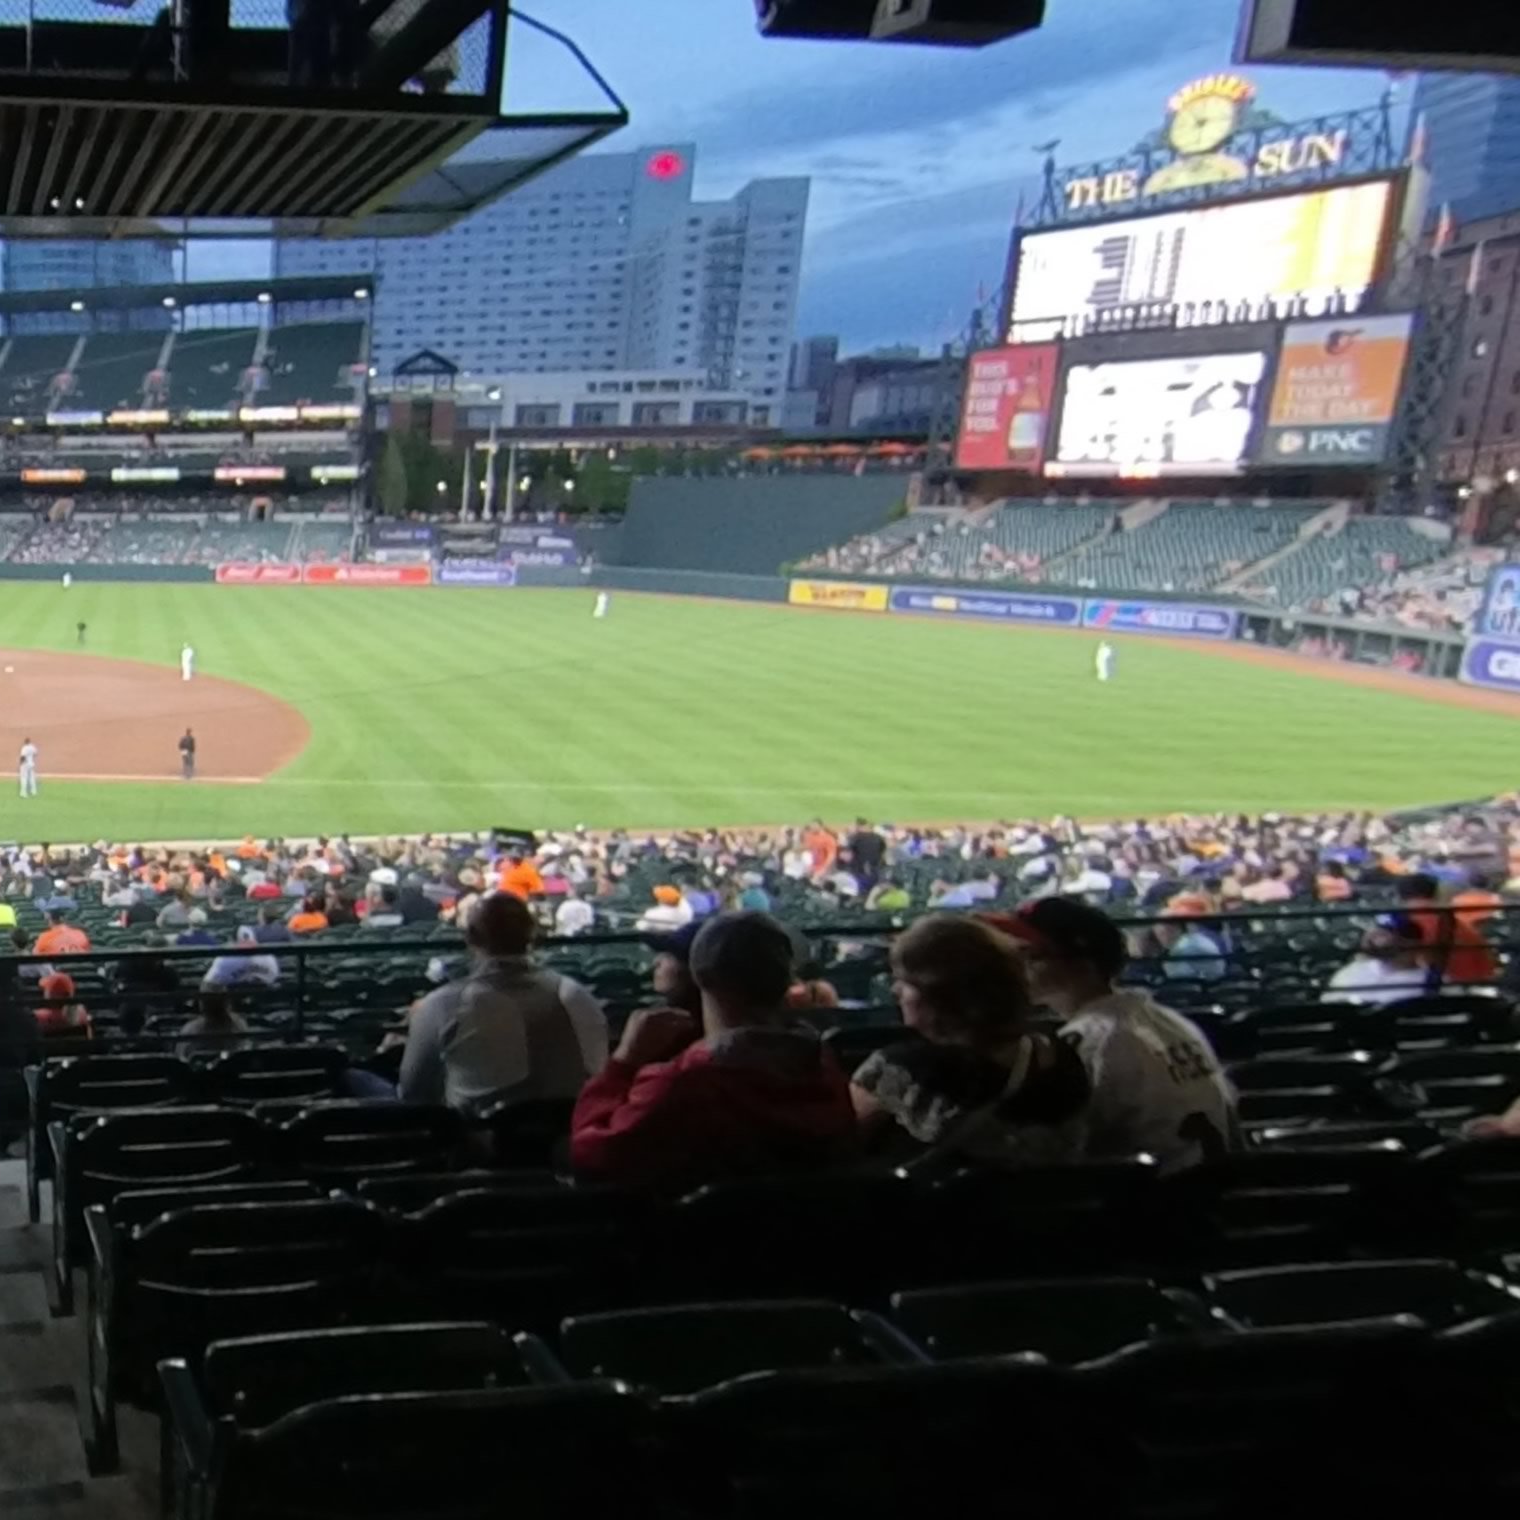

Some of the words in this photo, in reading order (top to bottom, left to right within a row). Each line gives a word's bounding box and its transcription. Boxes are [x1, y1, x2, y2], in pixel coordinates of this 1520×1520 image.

[1065, 167, 1137, 209] THE
[1254, 129, 1347, 177] SUN
[974, 360, 1009, 380] THIS
[1288, 362, 1352, 381] MAKE
[1284, 381, 1354, 399] TODAY
[967, 397, 999, 415] FOR
[1281, 399, 1324, 418] THE
[1327, 398, 1374, 418] DAY
[1308, 429, 1373, 452] PNC
